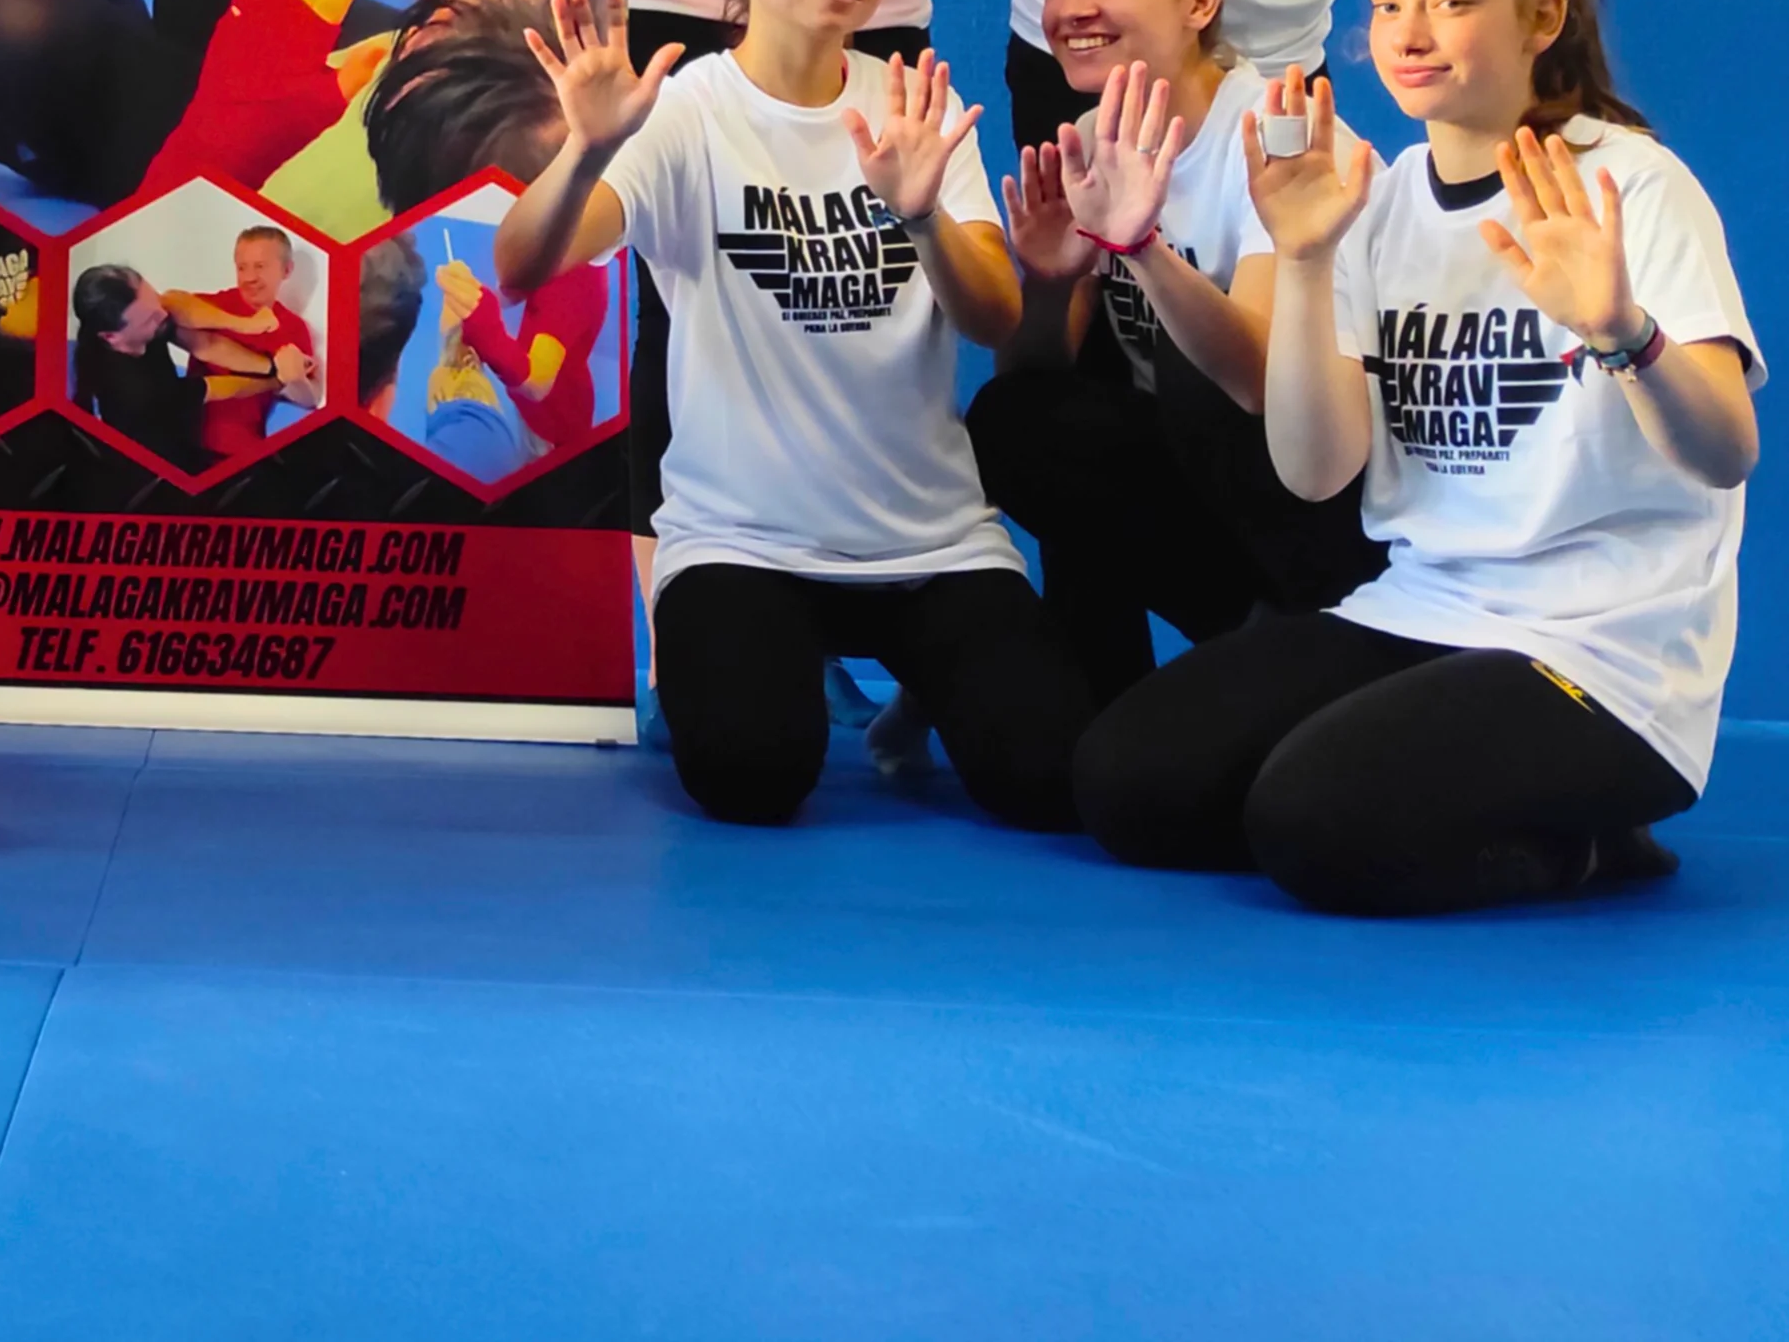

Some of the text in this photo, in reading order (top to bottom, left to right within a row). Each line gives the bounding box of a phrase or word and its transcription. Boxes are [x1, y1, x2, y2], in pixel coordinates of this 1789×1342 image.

[743, 184, 884, 237] MÁLAG
[786, 231, 879, 274] KRAV
[791, 272, 884, 309] MAGA
[1399, 362, 1494, 407] KRAV
[1403, 410, 1496, 448] MAGA
[115, 629, 337, 680] 616634687
